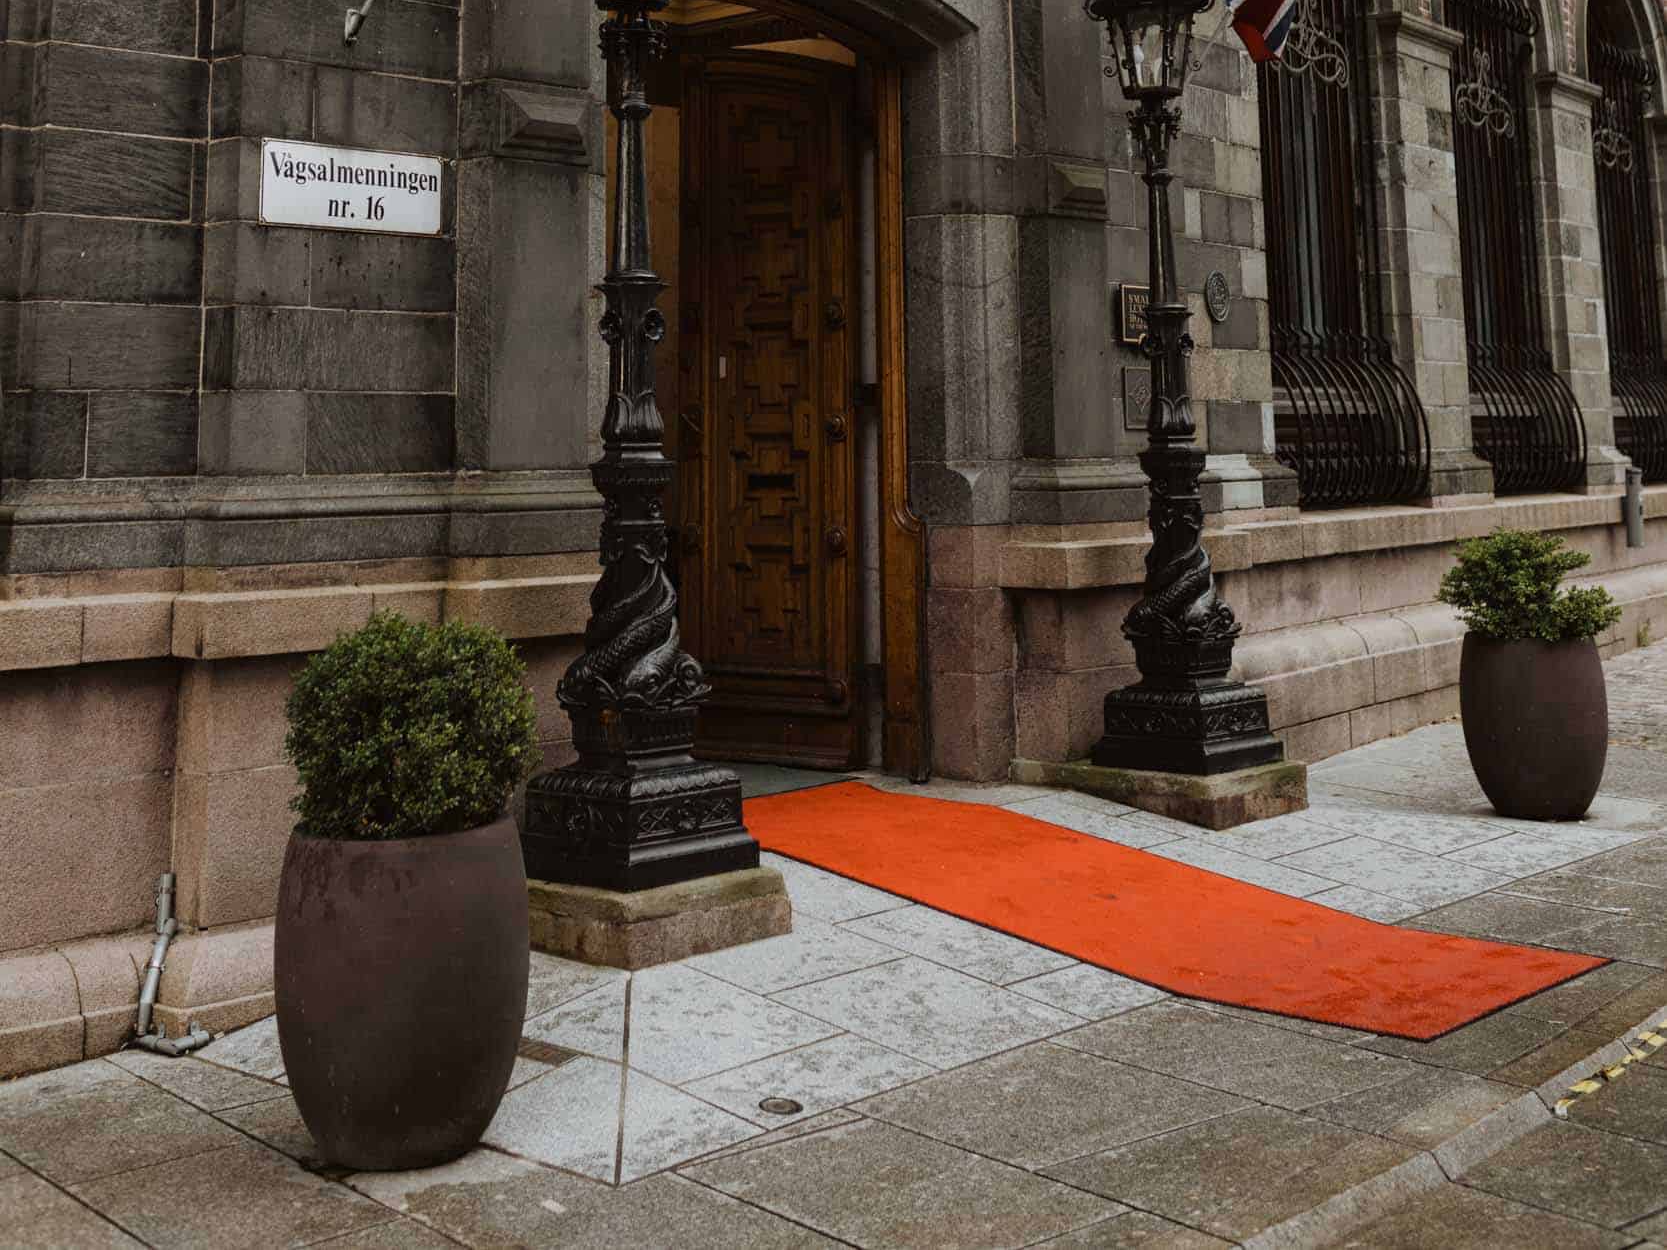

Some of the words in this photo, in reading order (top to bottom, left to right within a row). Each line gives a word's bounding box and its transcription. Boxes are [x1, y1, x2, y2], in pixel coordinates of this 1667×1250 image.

[270, 151, 438, 194] Vågsalmenningen
[328, 197, 354, 218] nr.
[366, 196, 385, 221] 16
